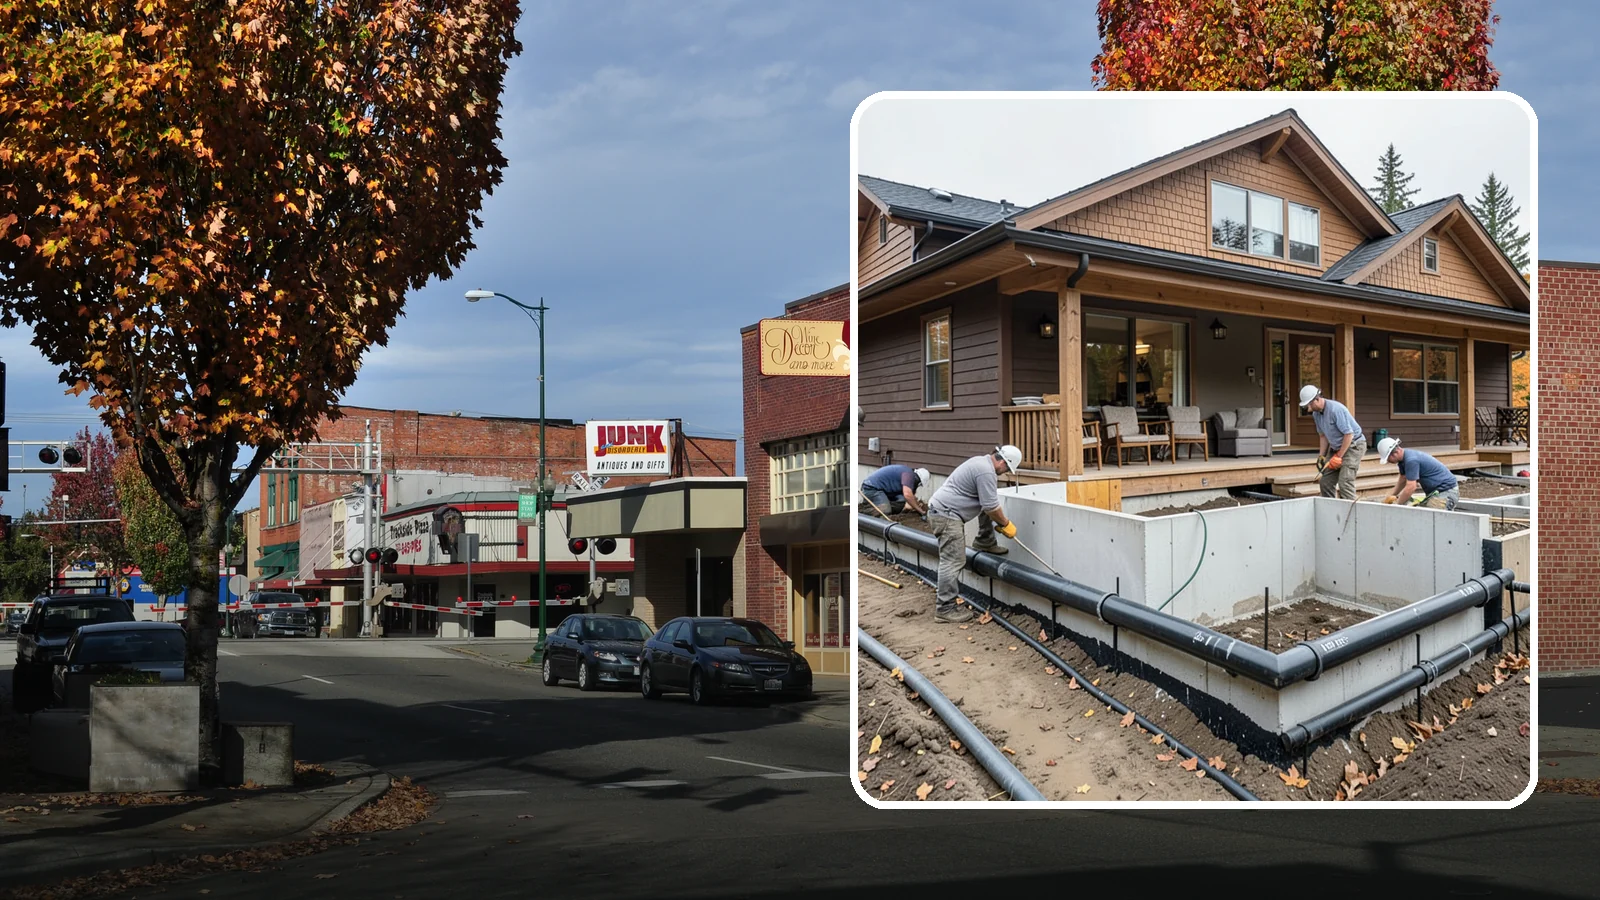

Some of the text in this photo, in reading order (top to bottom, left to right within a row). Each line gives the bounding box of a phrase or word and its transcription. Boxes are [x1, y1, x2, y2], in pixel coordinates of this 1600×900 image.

[595, 425, 665, 457] JUNK
[608, 446, 646, 454] DISORDERLY
[597, 460, 665, 470] ANTIQUES AND GIFTS
[572, 473, 590, 491] RAIL
